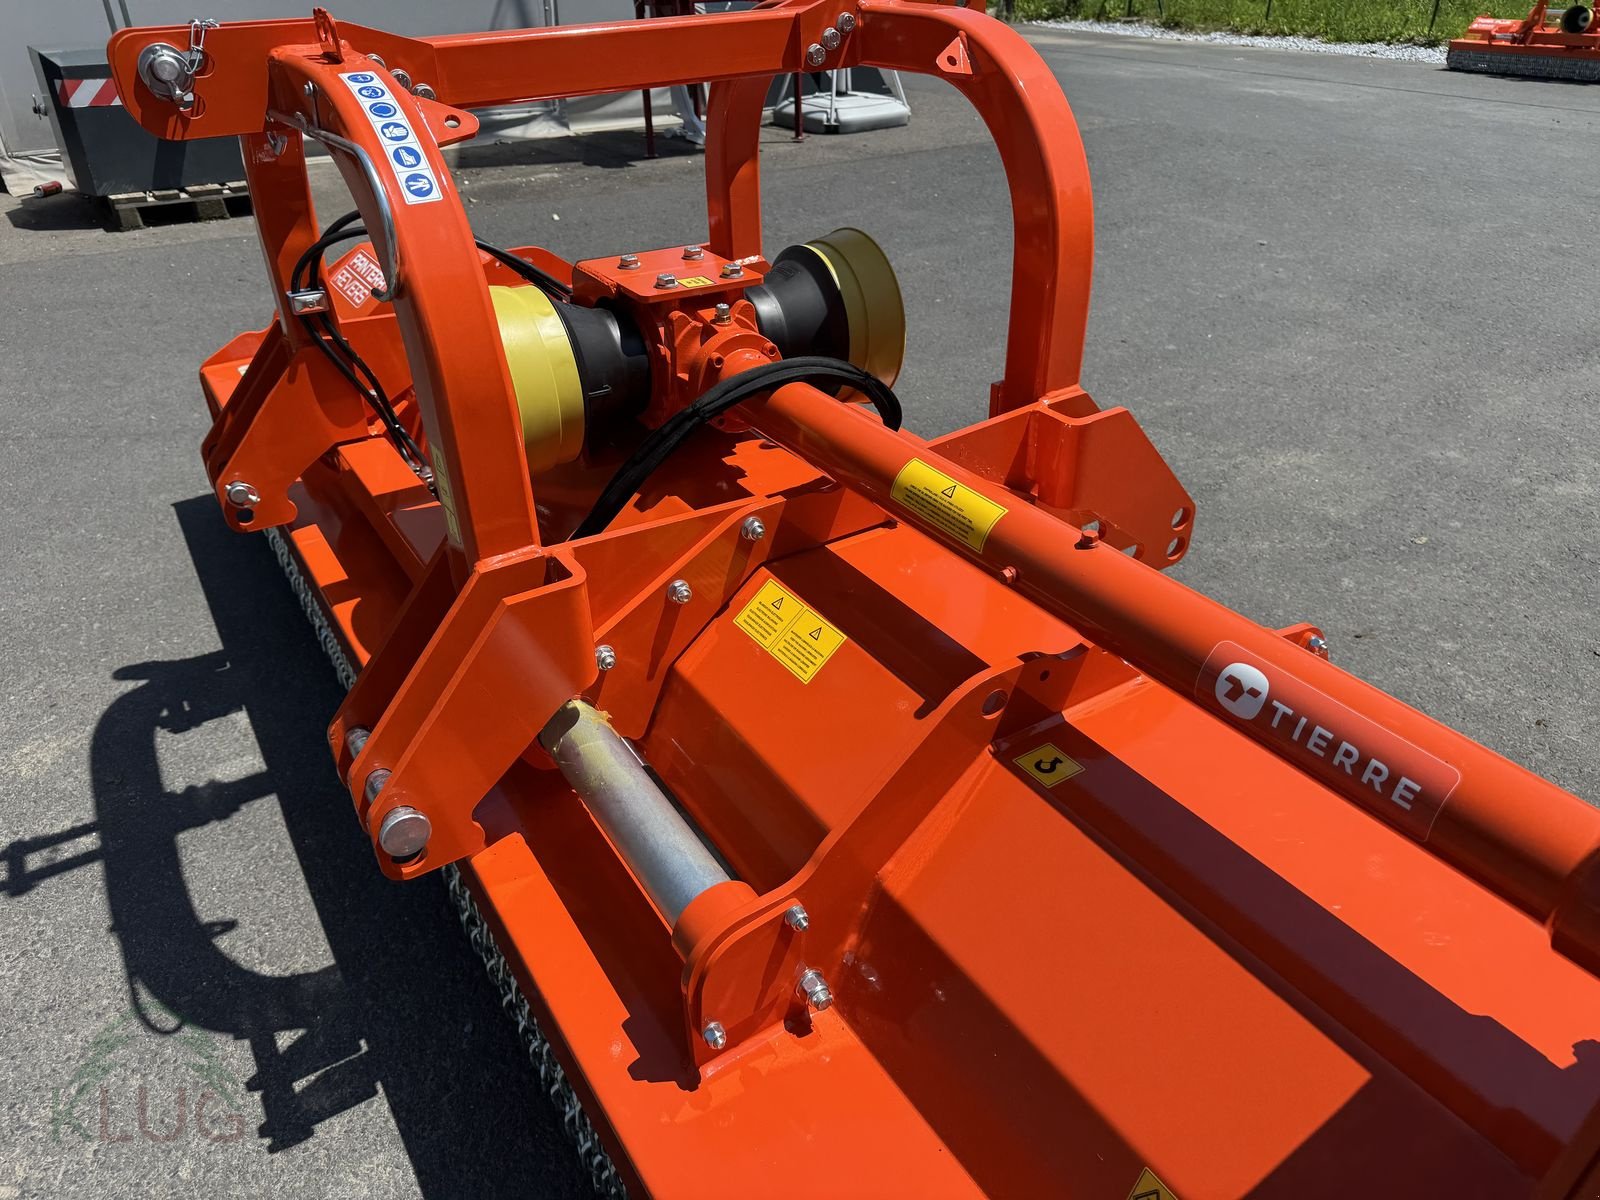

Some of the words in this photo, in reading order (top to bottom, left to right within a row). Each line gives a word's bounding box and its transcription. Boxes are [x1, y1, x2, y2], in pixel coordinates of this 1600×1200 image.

[334, 269, 369, 304] REVERS
[351, 253, 387, 292] PANTERA
[1271, 700, 1422, 811] TIERRE
